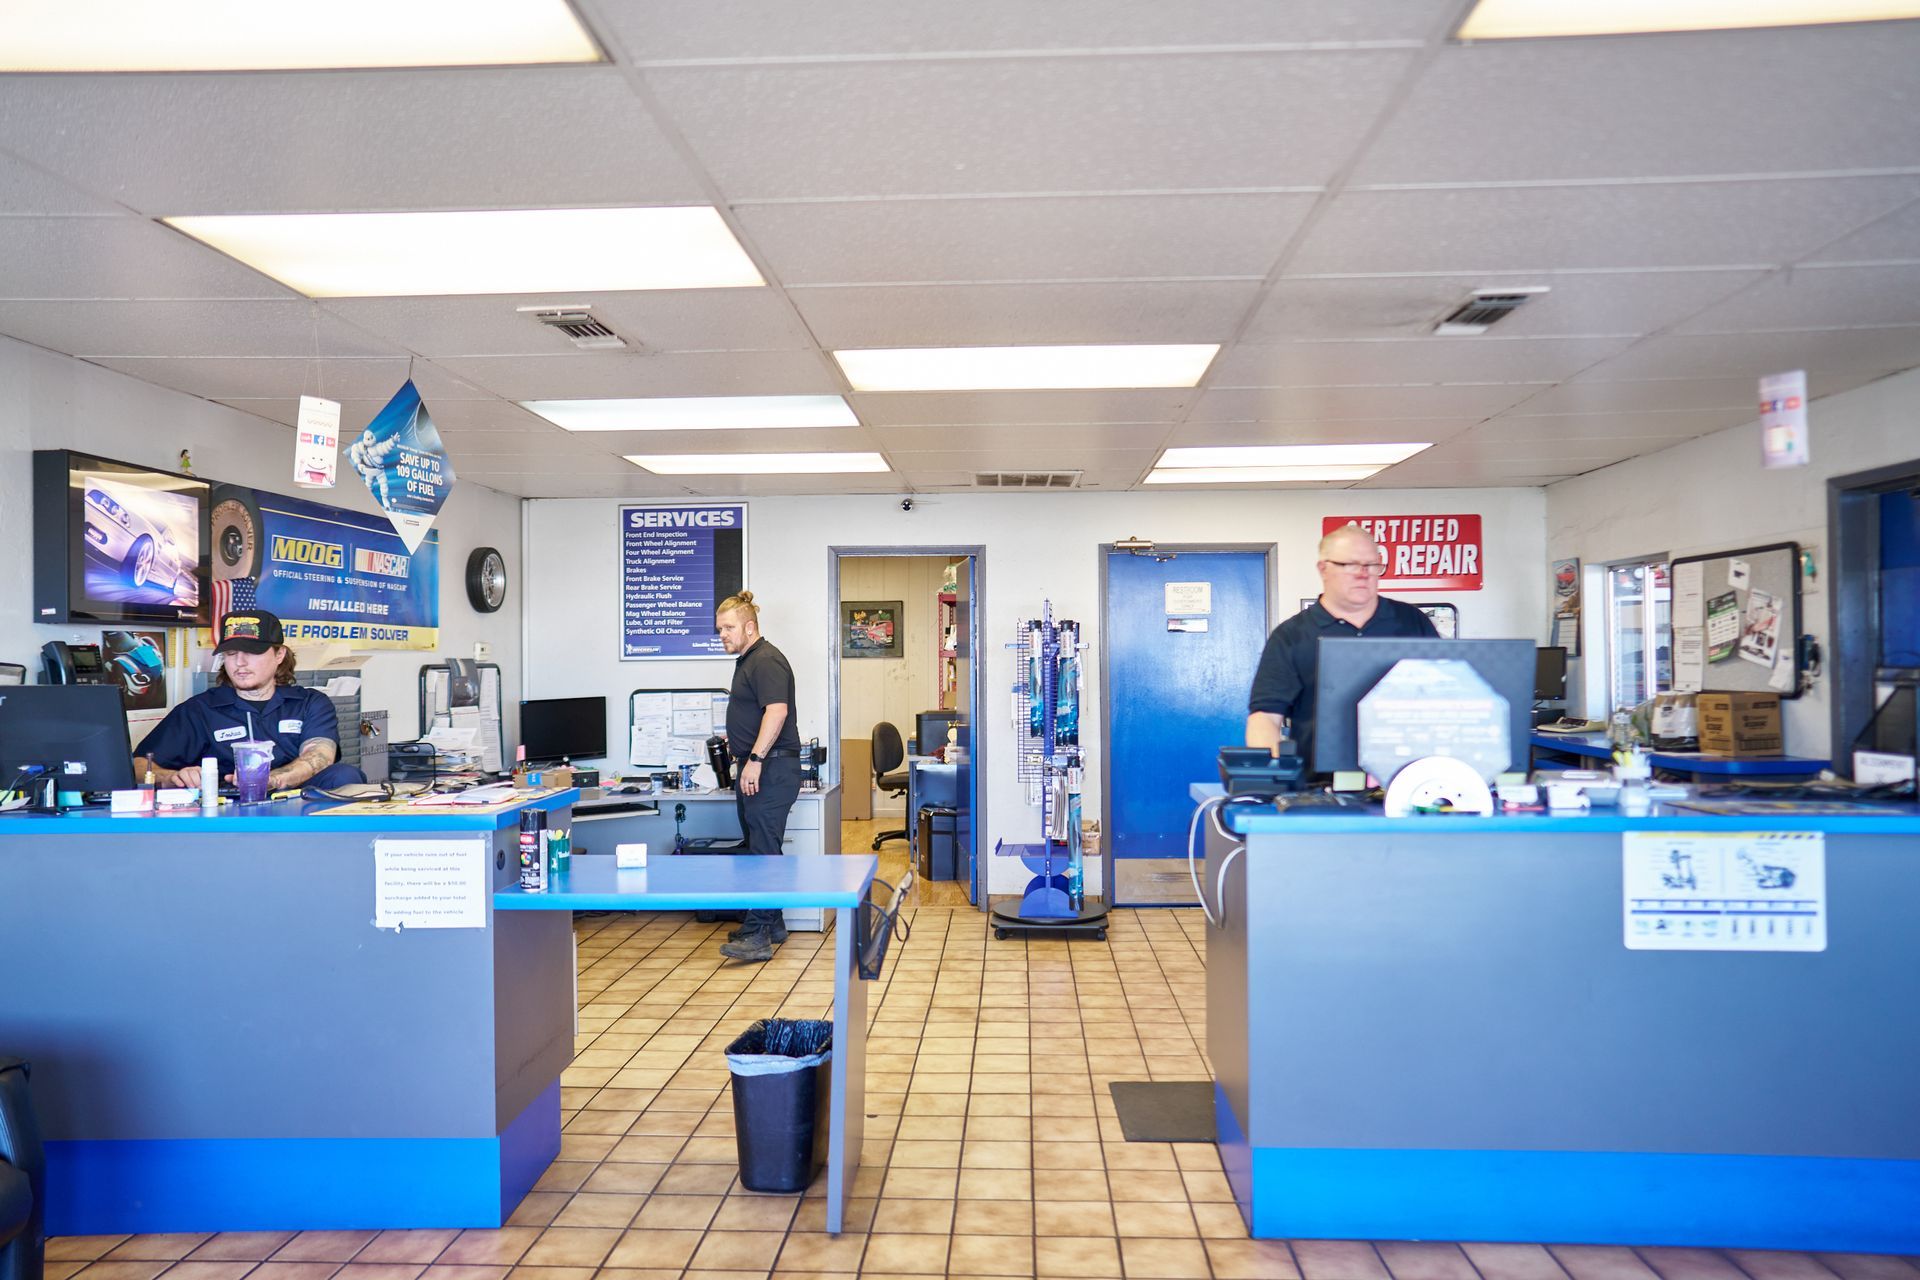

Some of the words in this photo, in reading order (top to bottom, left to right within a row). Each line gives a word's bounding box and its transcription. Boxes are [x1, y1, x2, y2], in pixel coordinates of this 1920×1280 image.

[400, 452, 419, 467] SAVE
[420, 457, 430, 469] UP
[431, 460, 439, 472] TO
[396, 465, 410, 478] 109
[412, 469, 443, 486] GALLONS
[407, 482, 418, 492] OF
[419, 485, 435, 496] FUEL
[631, 511, 735, 528] SERVICES
[1347, 519, 1459, 542] ERTIFIED
[273, 538, 341, 566] MOOG
[372, 556, 408, 578] NASCAR
[1395, 544, 1478, 575] REPAIR
[273, 569, 302, 580] OFFICIAL
[304, 573, 335, 583] STEERING
[337, 576, 342, 584] &
[345, 576, 377, 588] SUSPENSION
[308, 599, 365, 613] INSTALLED
[367, 603, 388, 615] HERE
[282, 624, 298, 638] HE
[302, 624, 367, 639] PROBLEM
[371, 627, 409, 641] SOLVER
